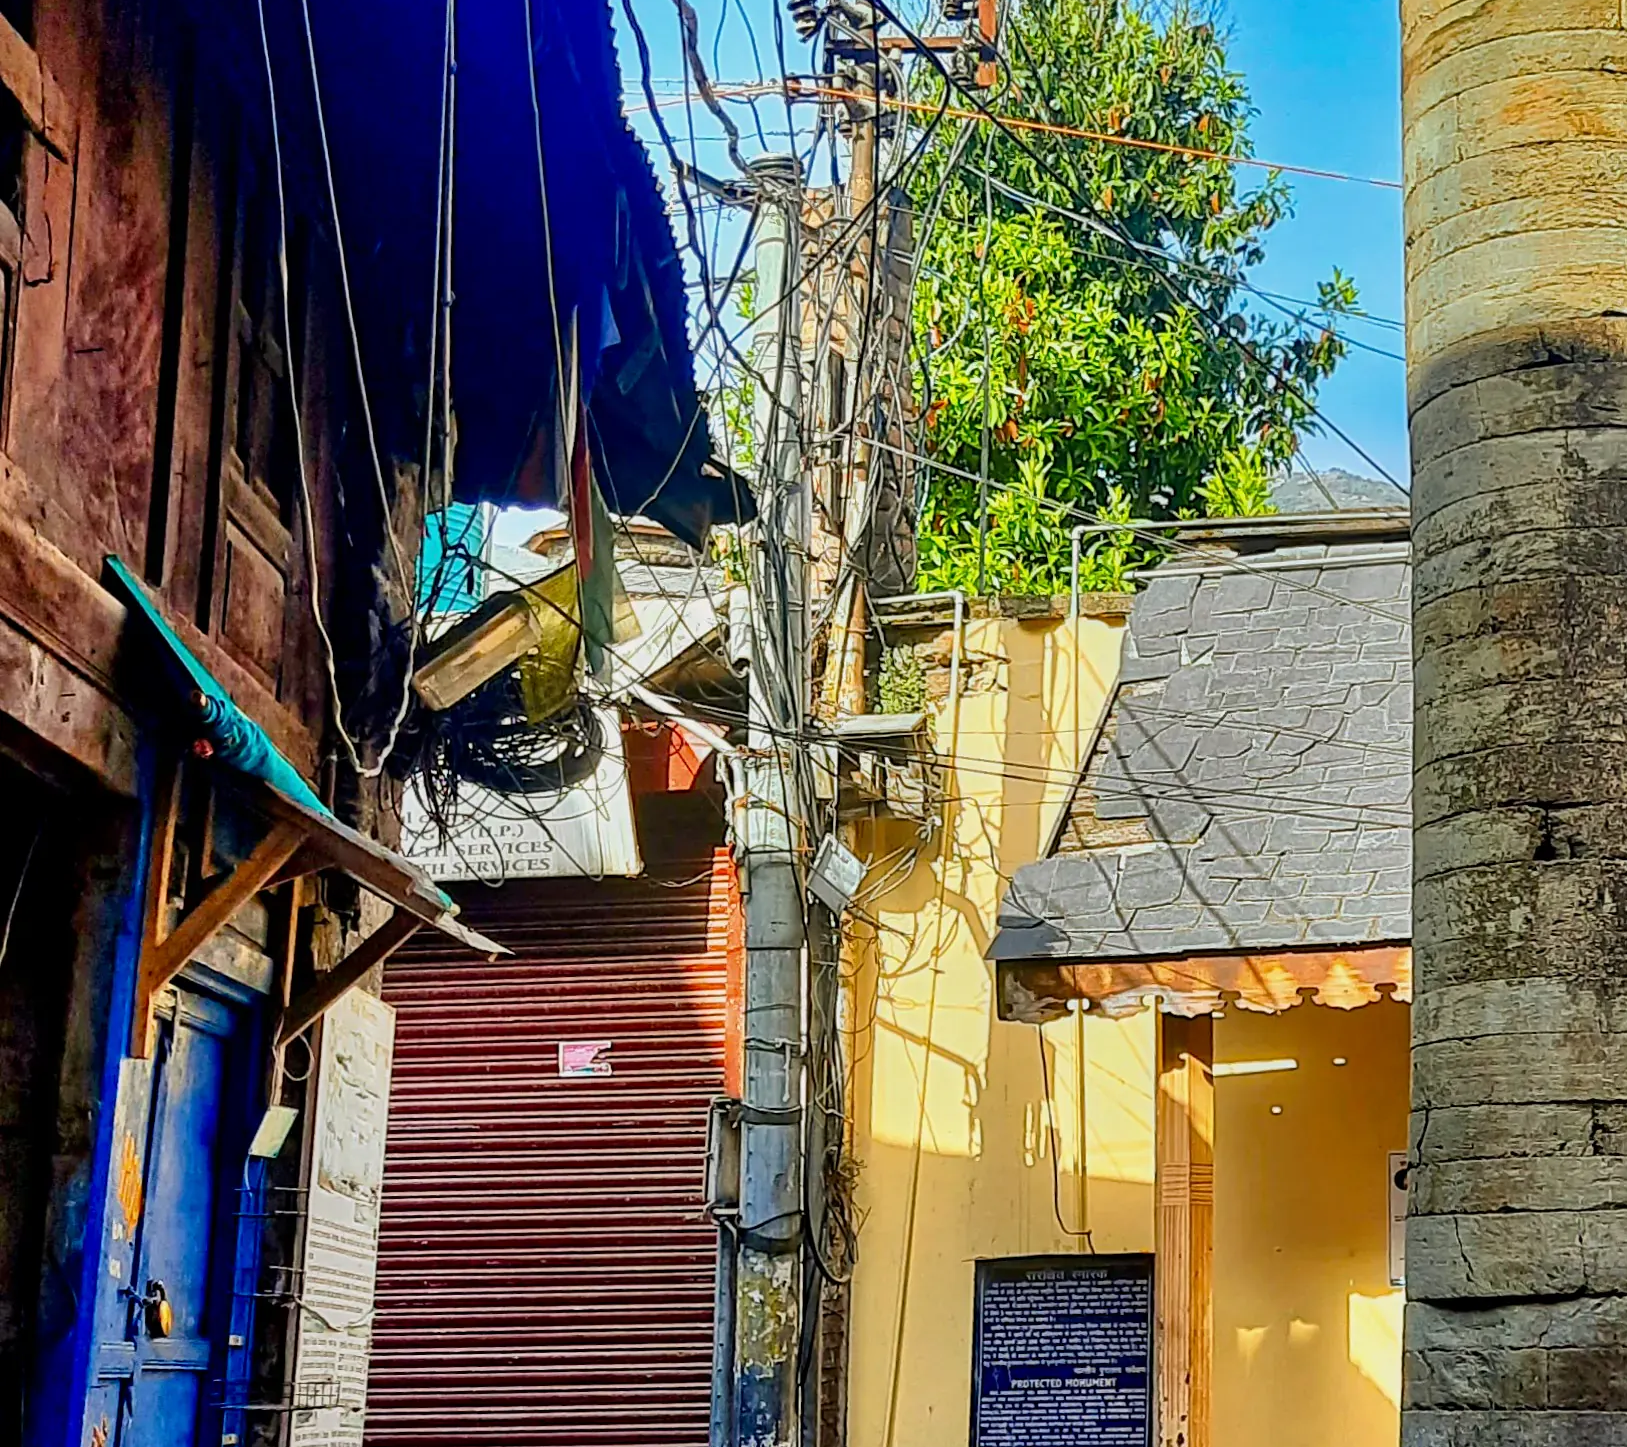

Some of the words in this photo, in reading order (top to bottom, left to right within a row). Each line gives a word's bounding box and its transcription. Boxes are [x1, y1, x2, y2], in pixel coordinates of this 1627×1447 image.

[451, 857, 550, 875] SERVICES
[1010, 1378, 1062, 1389] PROTECTED
[1065, 1377, 1118, 1388] MONUMENT
